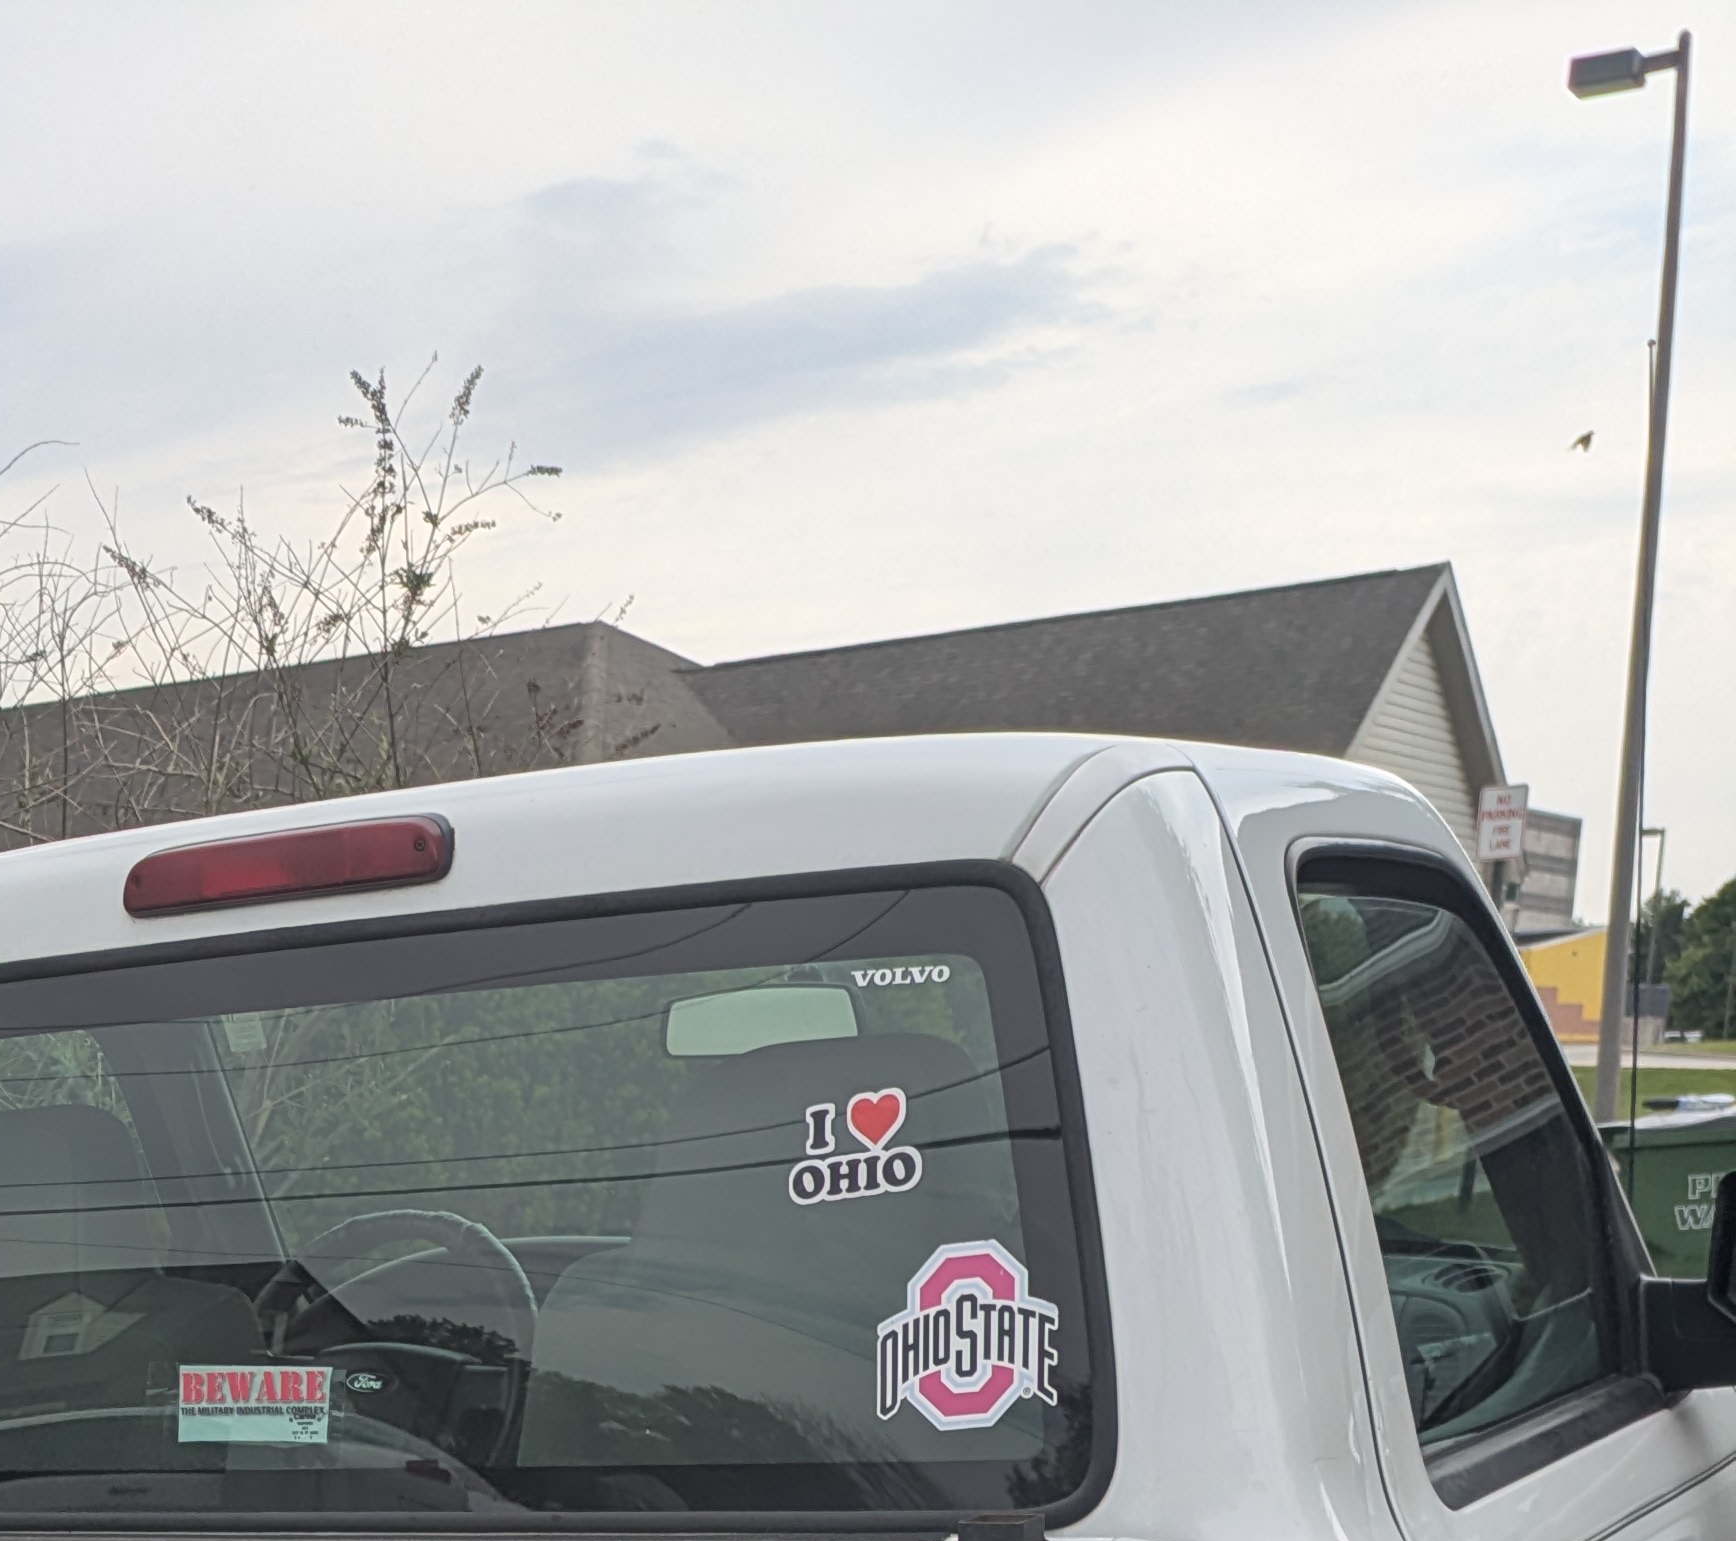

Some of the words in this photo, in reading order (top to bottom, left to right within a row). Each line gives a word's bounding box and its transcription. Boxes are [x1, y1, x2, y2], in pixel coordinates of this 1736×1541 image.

[852, 966, 950, 988] VOLVO
[810, 1108, 831, 1150] I
[792, 1152, 917, 1195] OHIO
[181, 1370, 326, 1405] BEWARE
[354, 1374, 382, 1389] Ford
[197, 1406, 235, 1416] MILITARY
[236, 1406, 284, 1416] INDUSTRIAL
